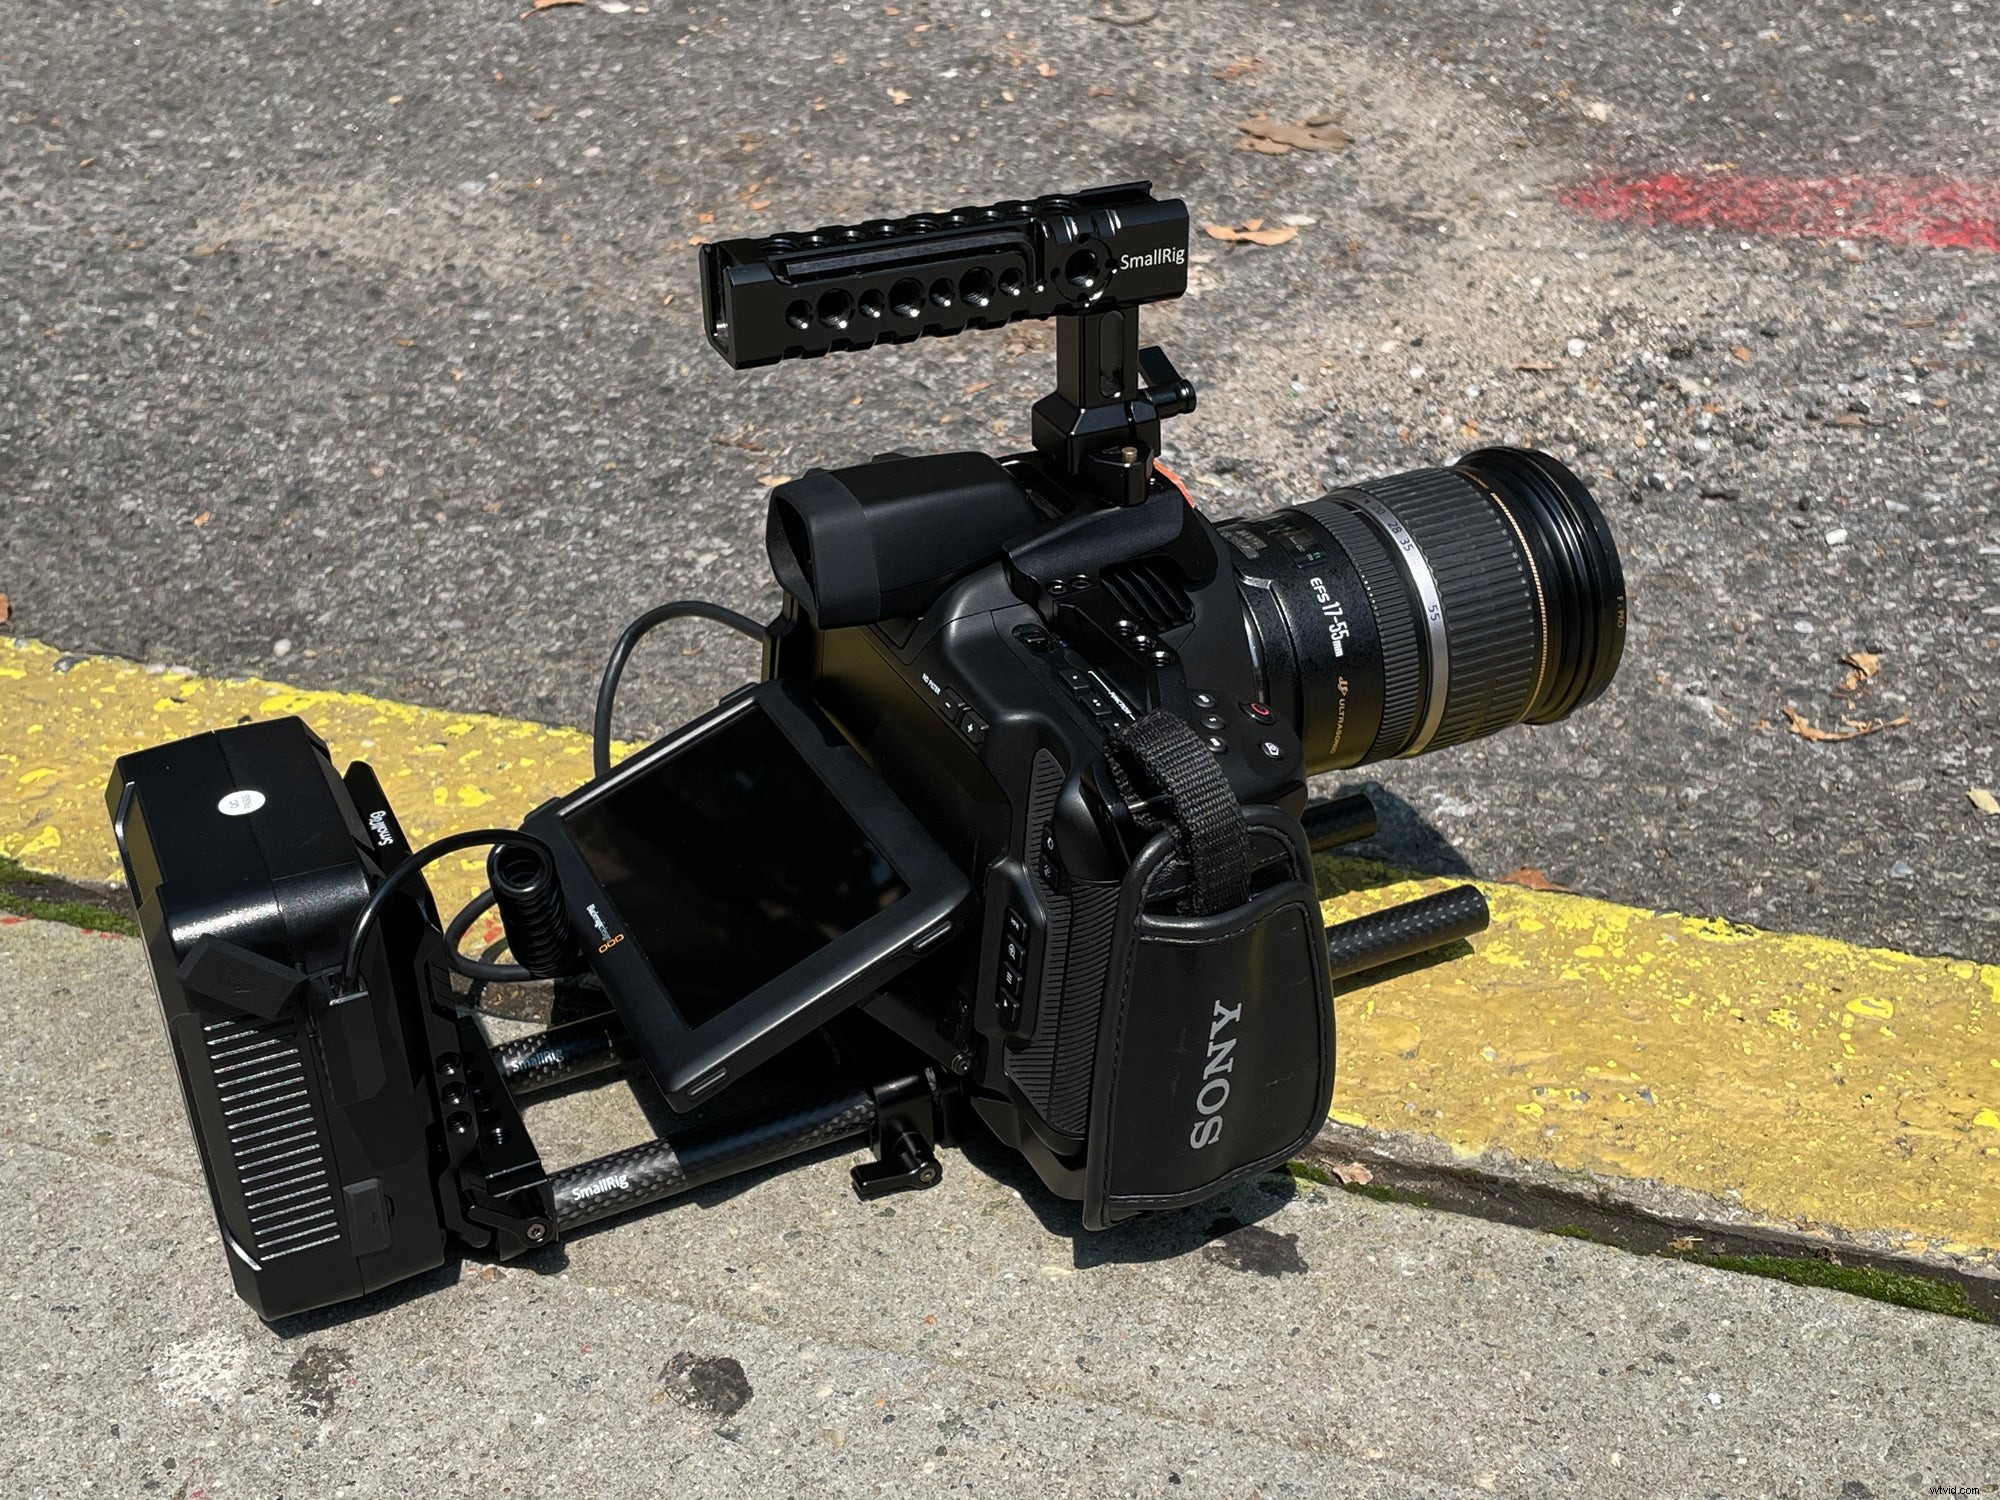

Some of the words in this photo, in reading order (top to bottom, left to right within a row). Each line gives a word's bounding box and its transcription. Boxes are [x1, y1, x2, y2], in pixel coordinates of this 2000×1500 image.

[1120, 247, 1185, 270] SmallRig
[1387, 521, 1402, 534] 28
[1400, 538, 1414, 551] 35
[1428, 605, 1441, 621] 55
[1309, 577, 1330, 605] EFS
[1321, 601, 1350, 658] 17-55mm
[1330, 698, 1346, 756] ULTRASONIC
[369, 811, 393, 845] SmallRig
[510, 1049, 564, 1073] SmallRig
[1189, 999, 1242, 1150] SONY
[571, 1174, 630, 1201] SmallRig
